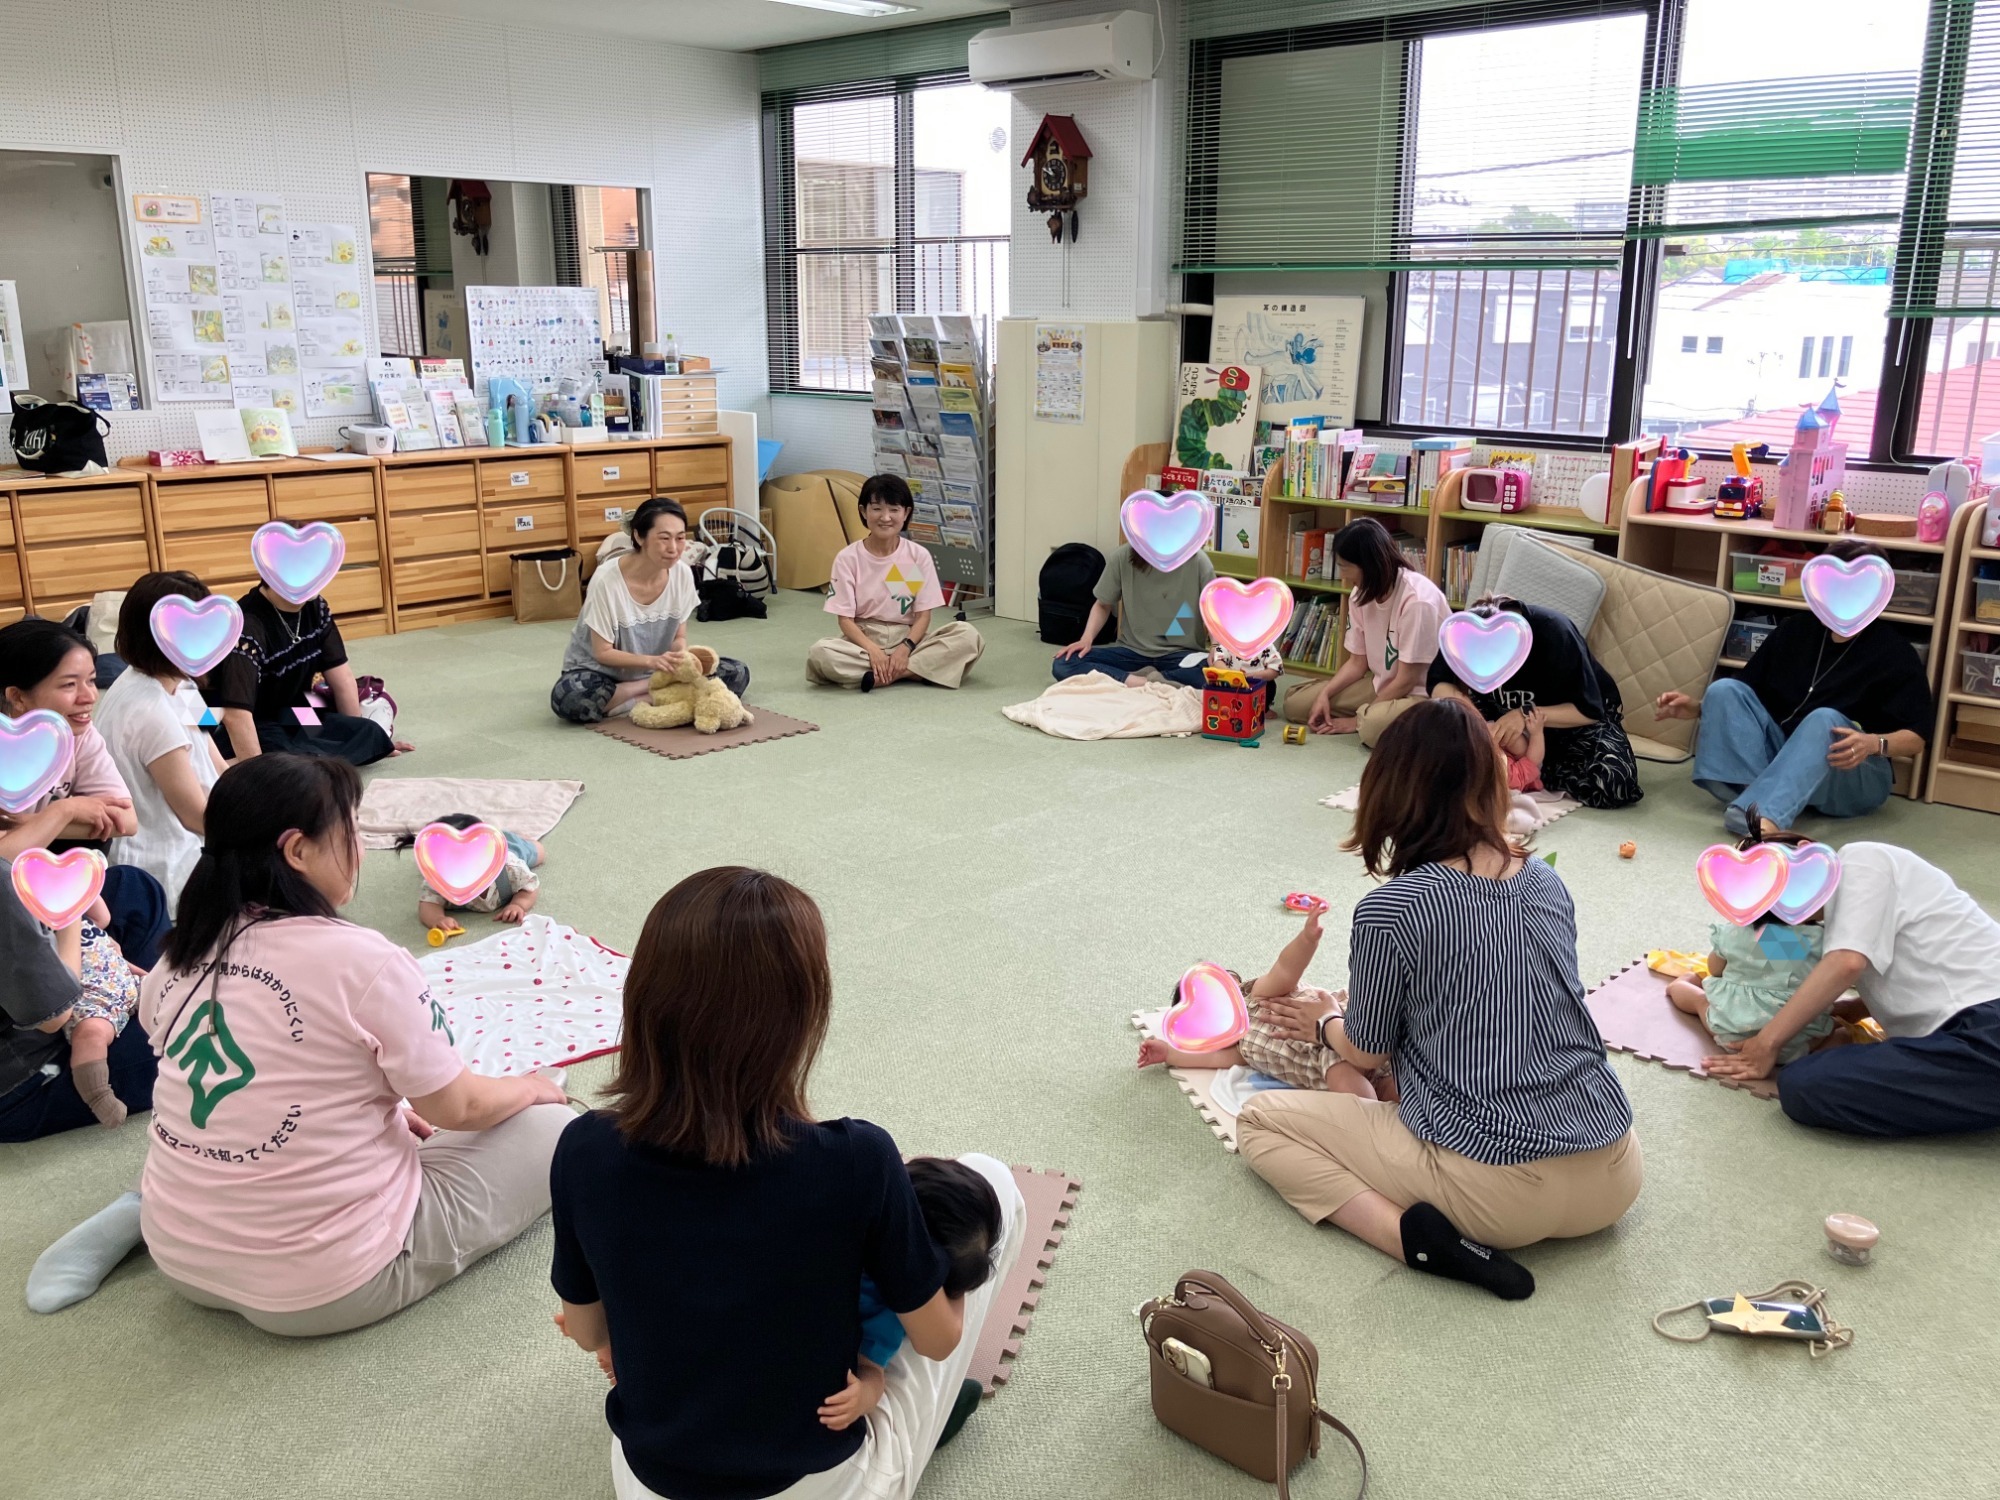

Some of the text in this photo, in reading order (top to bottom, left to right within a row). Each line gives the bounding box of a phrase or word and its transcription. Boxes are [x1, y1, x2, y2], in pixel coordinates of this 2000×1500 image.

[1263, 304, 1307, 313] 耳の構造図
[1181, 366, 1192, 396] はらぺこ
[1189, 366, 1200, 397] あおむし
[1208, 477, 1234, 487] たてもの
[1459, 1238, 1490, 1260] POCHACCO
